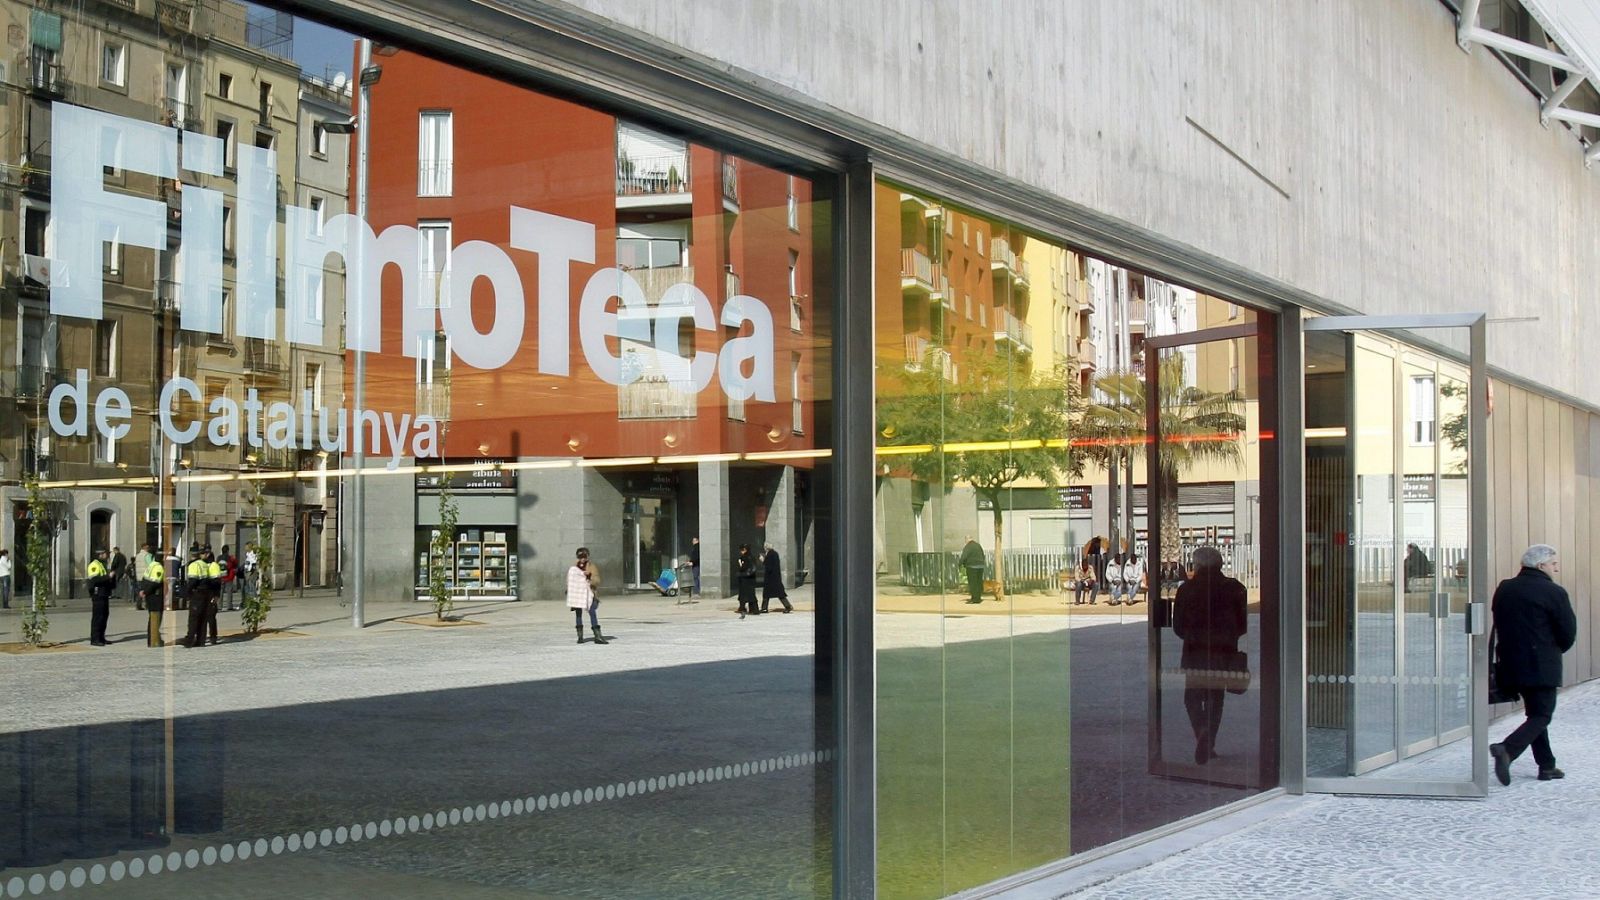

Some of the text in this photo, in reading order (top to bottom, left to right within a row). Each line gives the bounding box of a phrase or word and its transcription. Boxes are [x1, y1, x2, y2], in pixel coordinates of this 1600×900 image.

[50, 101, 776, 403] FilmoTeca
[48, 368, 438, 471] de Catalunya
